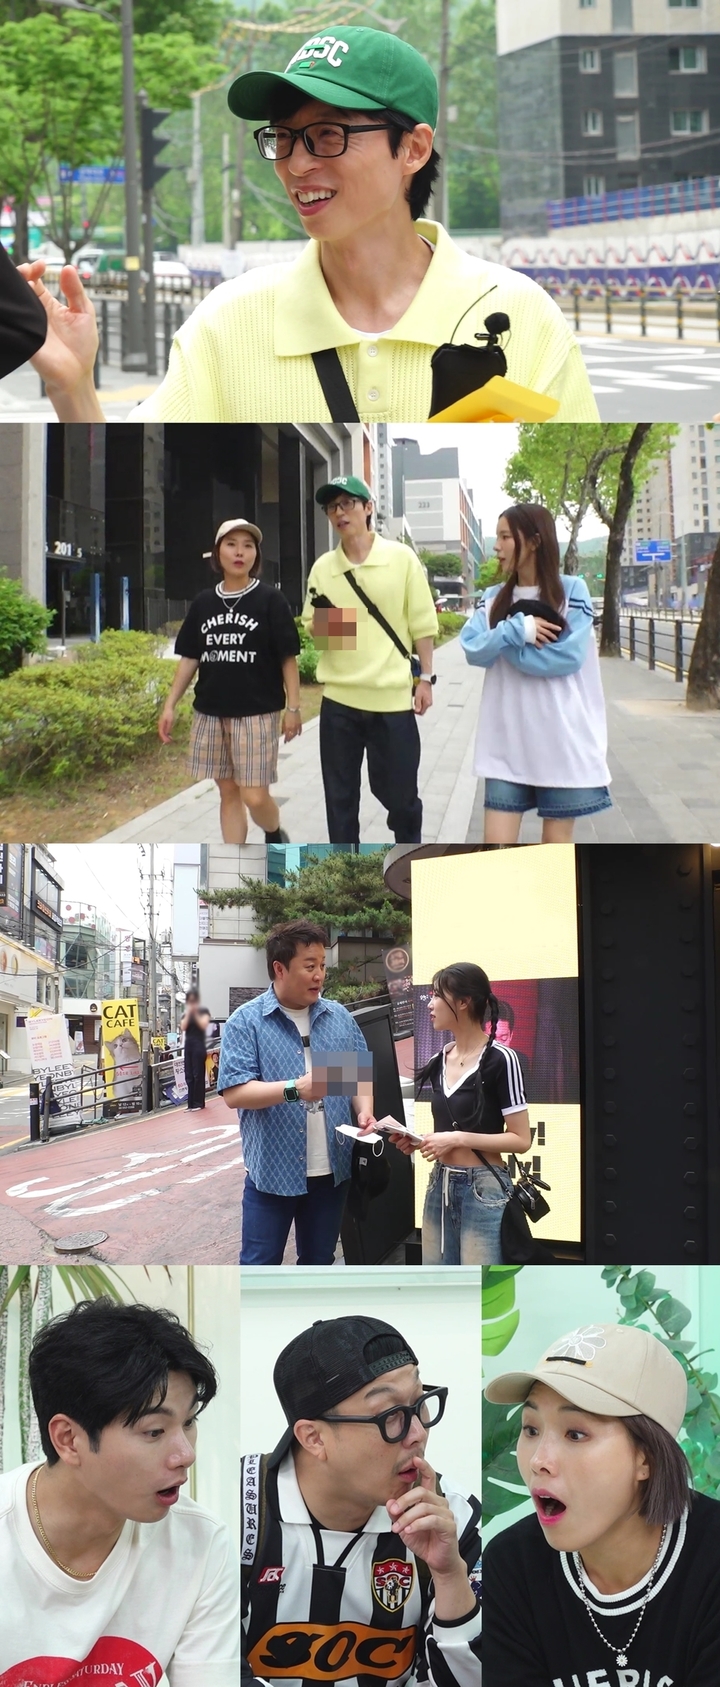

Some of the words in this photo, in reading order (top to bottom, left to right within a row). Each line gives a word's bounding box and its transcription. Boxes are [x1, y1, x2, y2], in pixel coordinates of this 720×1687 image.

[200, 613, 259, 634] CHERISH
[206, 632, 247, 646] EVERY
[200, 650, 257, 663] MOMENT
[103, 1004, 137, 1019] CAT
[106, 1019, 135, 1028] CAFE
